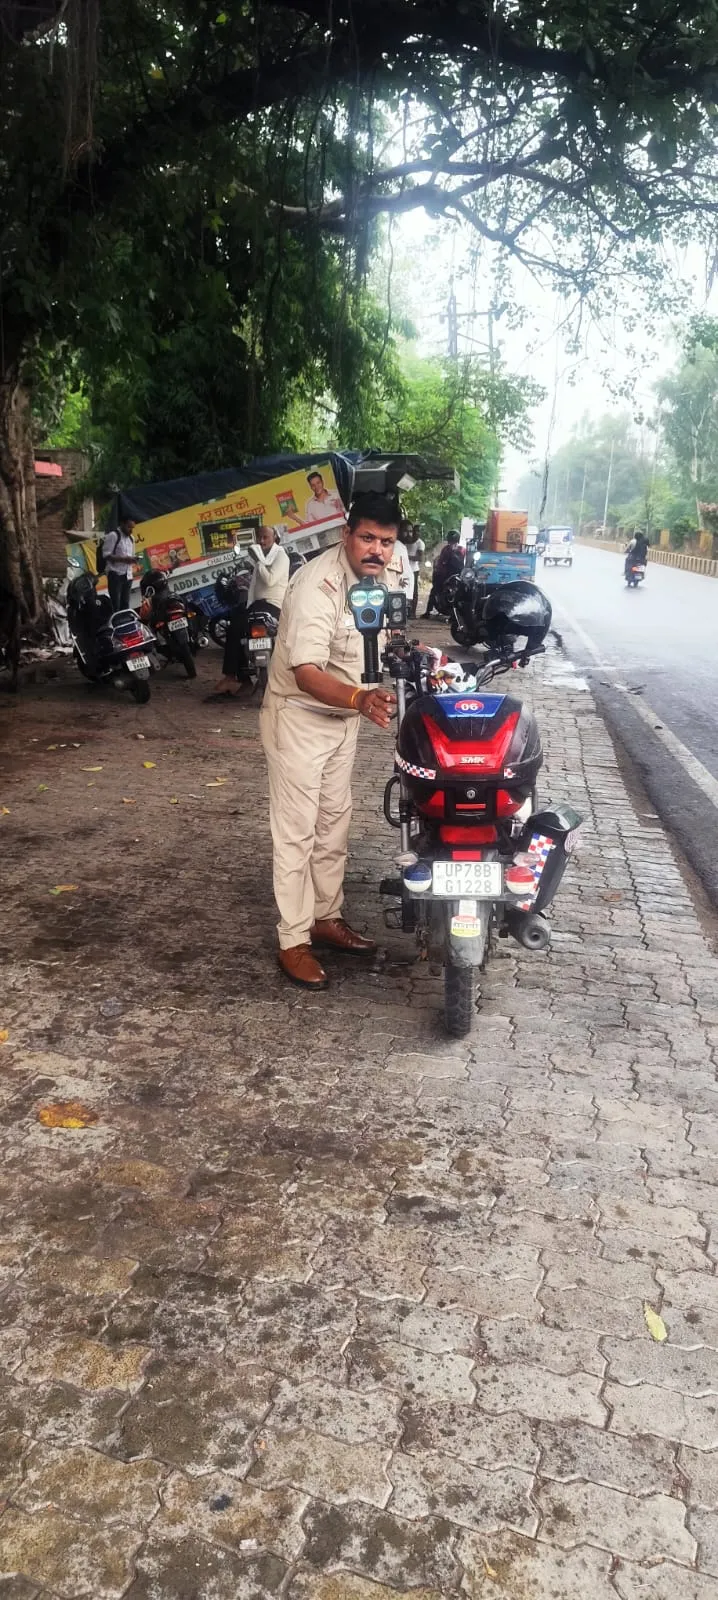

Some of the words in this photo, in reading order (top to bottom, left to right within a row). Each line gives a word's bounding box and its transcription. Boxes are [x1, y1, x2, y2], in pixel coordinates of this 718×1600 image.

[173, 577, 200, 592] ADDA
[201, 574, 210, 584] &
[460, 703, 479, 711] 06
[460, 756, 485, 764] SMK
[445, 863, 492, 878] UP78B
[445, 879, 492, 894] G1228
